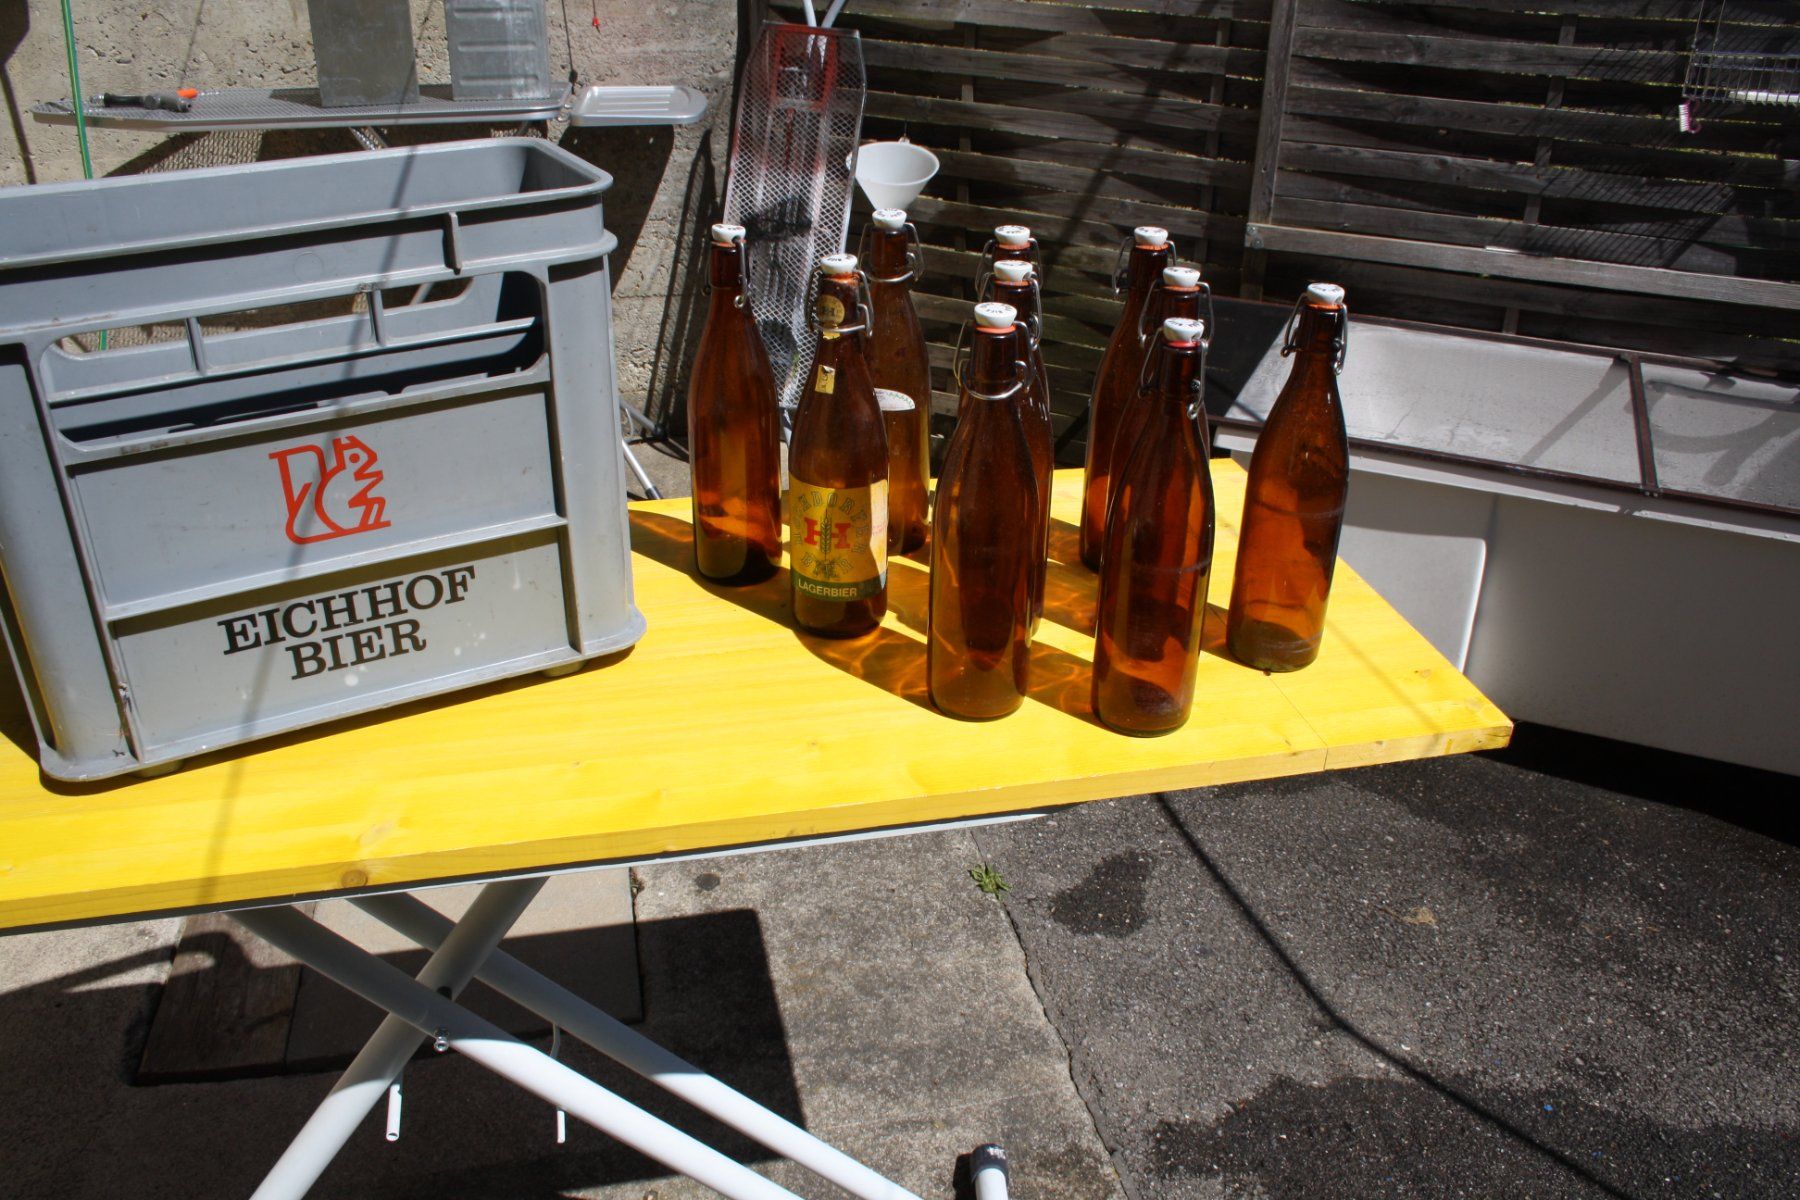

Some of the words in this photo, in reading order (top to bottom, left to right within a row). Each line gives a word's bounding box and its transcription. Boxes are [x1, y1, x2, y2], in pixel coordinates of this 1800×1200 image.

[217, 565, 475, 655] EICHHOF
[798, 579, 857, 597] LAGERBIER
[285, 618, 427, 680] BIER
